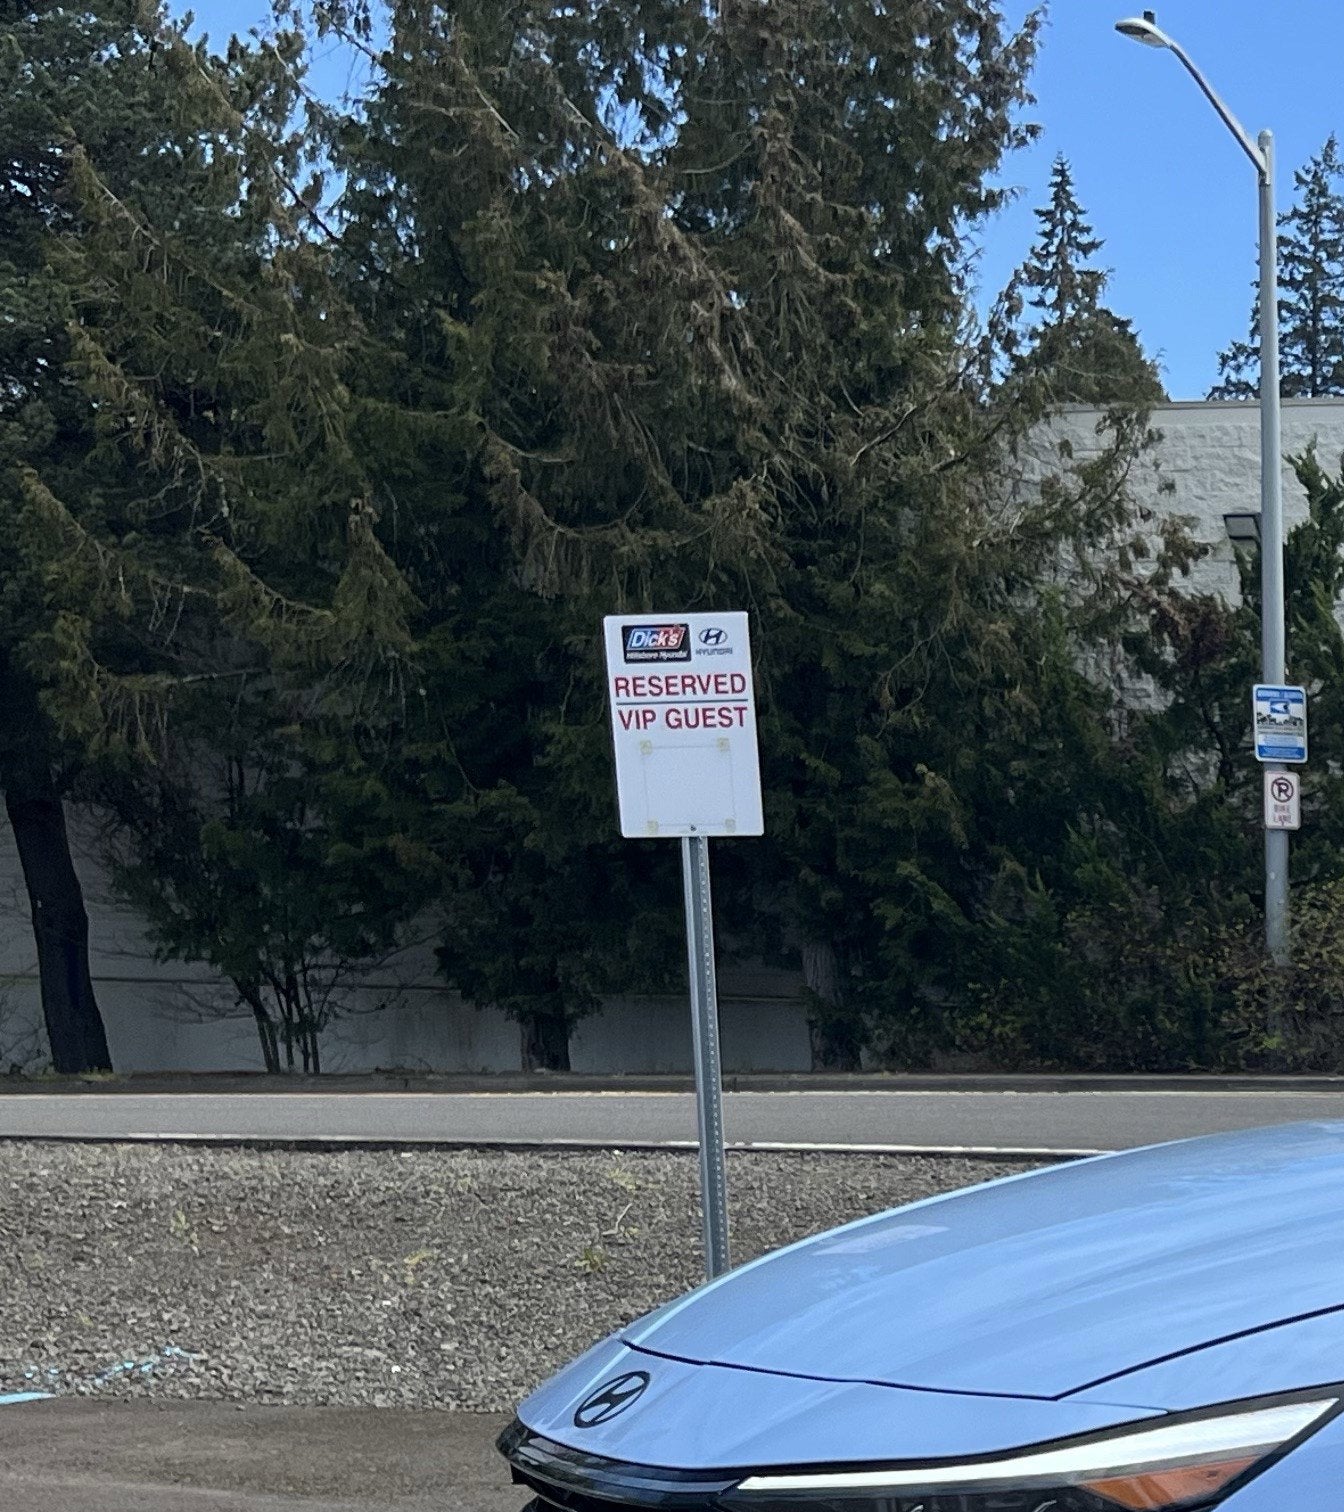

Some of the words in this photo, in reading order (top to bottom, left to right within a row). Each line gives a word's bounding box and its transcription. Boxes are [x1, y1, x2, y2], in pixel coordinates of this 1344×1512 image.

[631, 629, 679, 648] Dick's
[695, 648, 733, 656] HYUNDAI
[614, 673, 746, 698] RESERVED
[618, 709, 657, 730] VIP
[665, 706, 748, 729] GUEST
